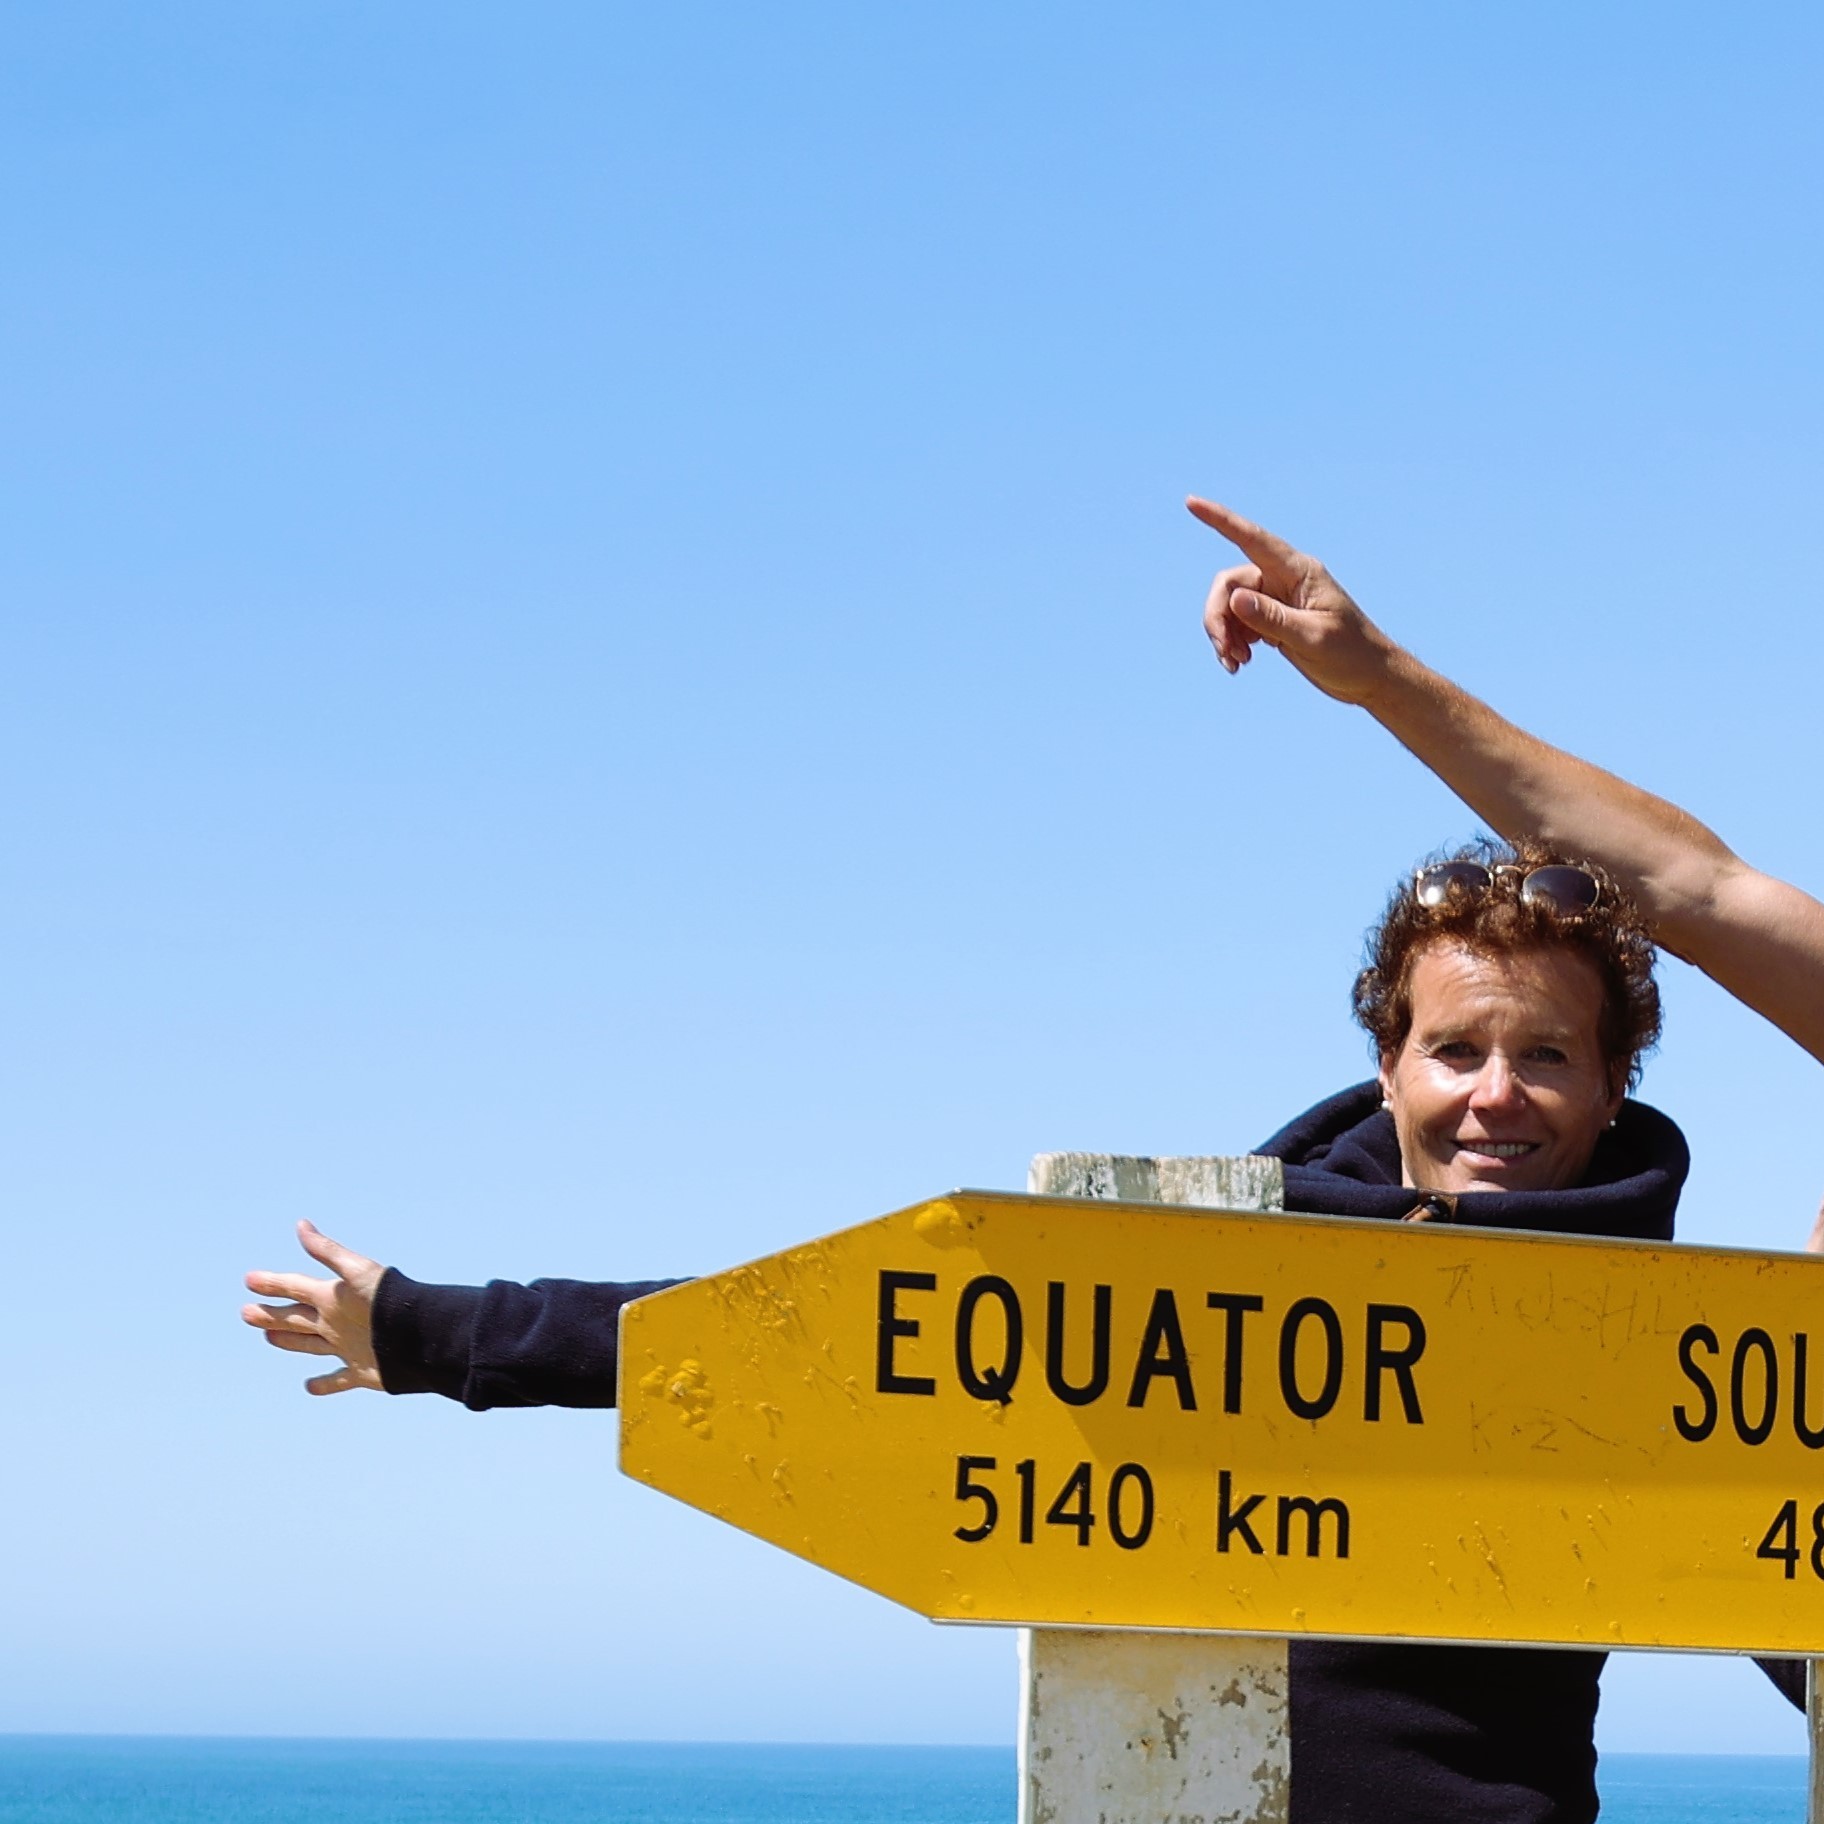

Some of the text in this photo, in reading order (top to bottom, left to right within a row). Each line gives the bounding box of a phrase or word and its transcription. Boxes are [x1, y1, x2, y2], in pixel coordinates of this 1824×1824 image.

[876, 1269, 1426, 1424] EQUATOR
[954, 1455, 1349, 1557] 5140 km
